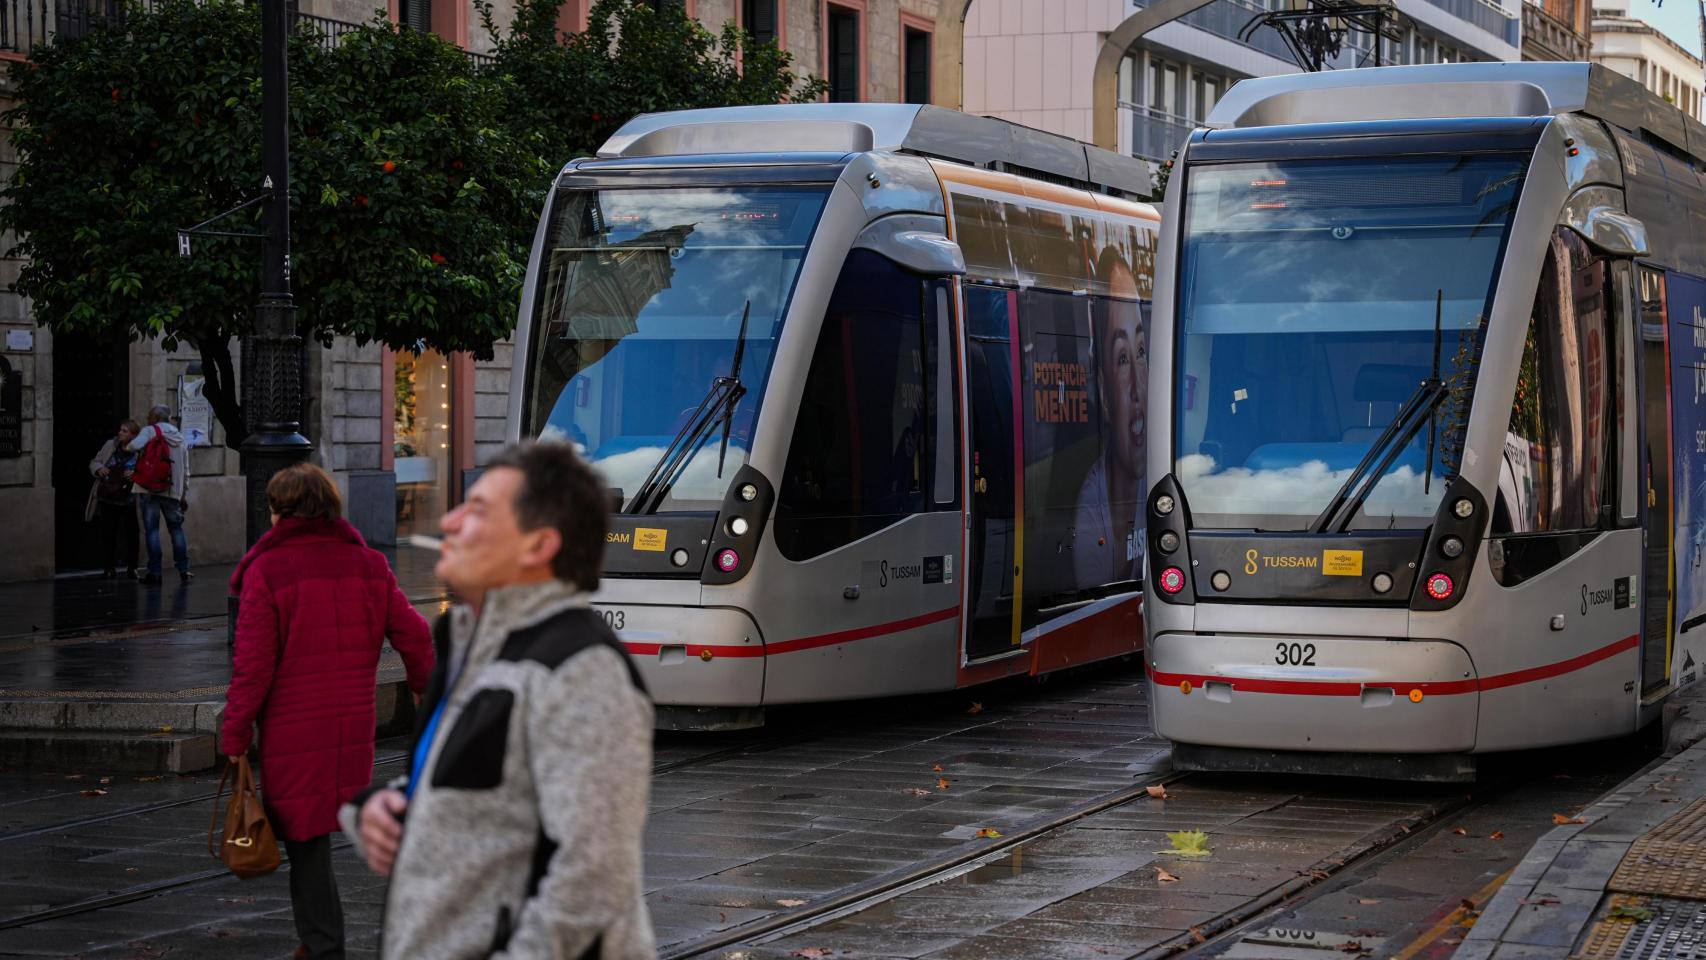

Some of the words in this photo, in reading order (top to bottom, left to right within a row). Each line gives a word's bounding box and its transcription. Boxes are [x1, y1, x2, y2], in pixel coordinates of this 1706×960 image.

[1034, 362, 1087, 385] POTENCIA
[1035, 389, 1088, 422] MENTE
[604, 532, 630, 543] SAM
[1263, 556, 1317, 568] TUSSAM
[890, 565, 921, 579] TUSSAM
[1589, 588, 1613, 605] TUSSAM
[1275, 642, 1316, 666] 302
